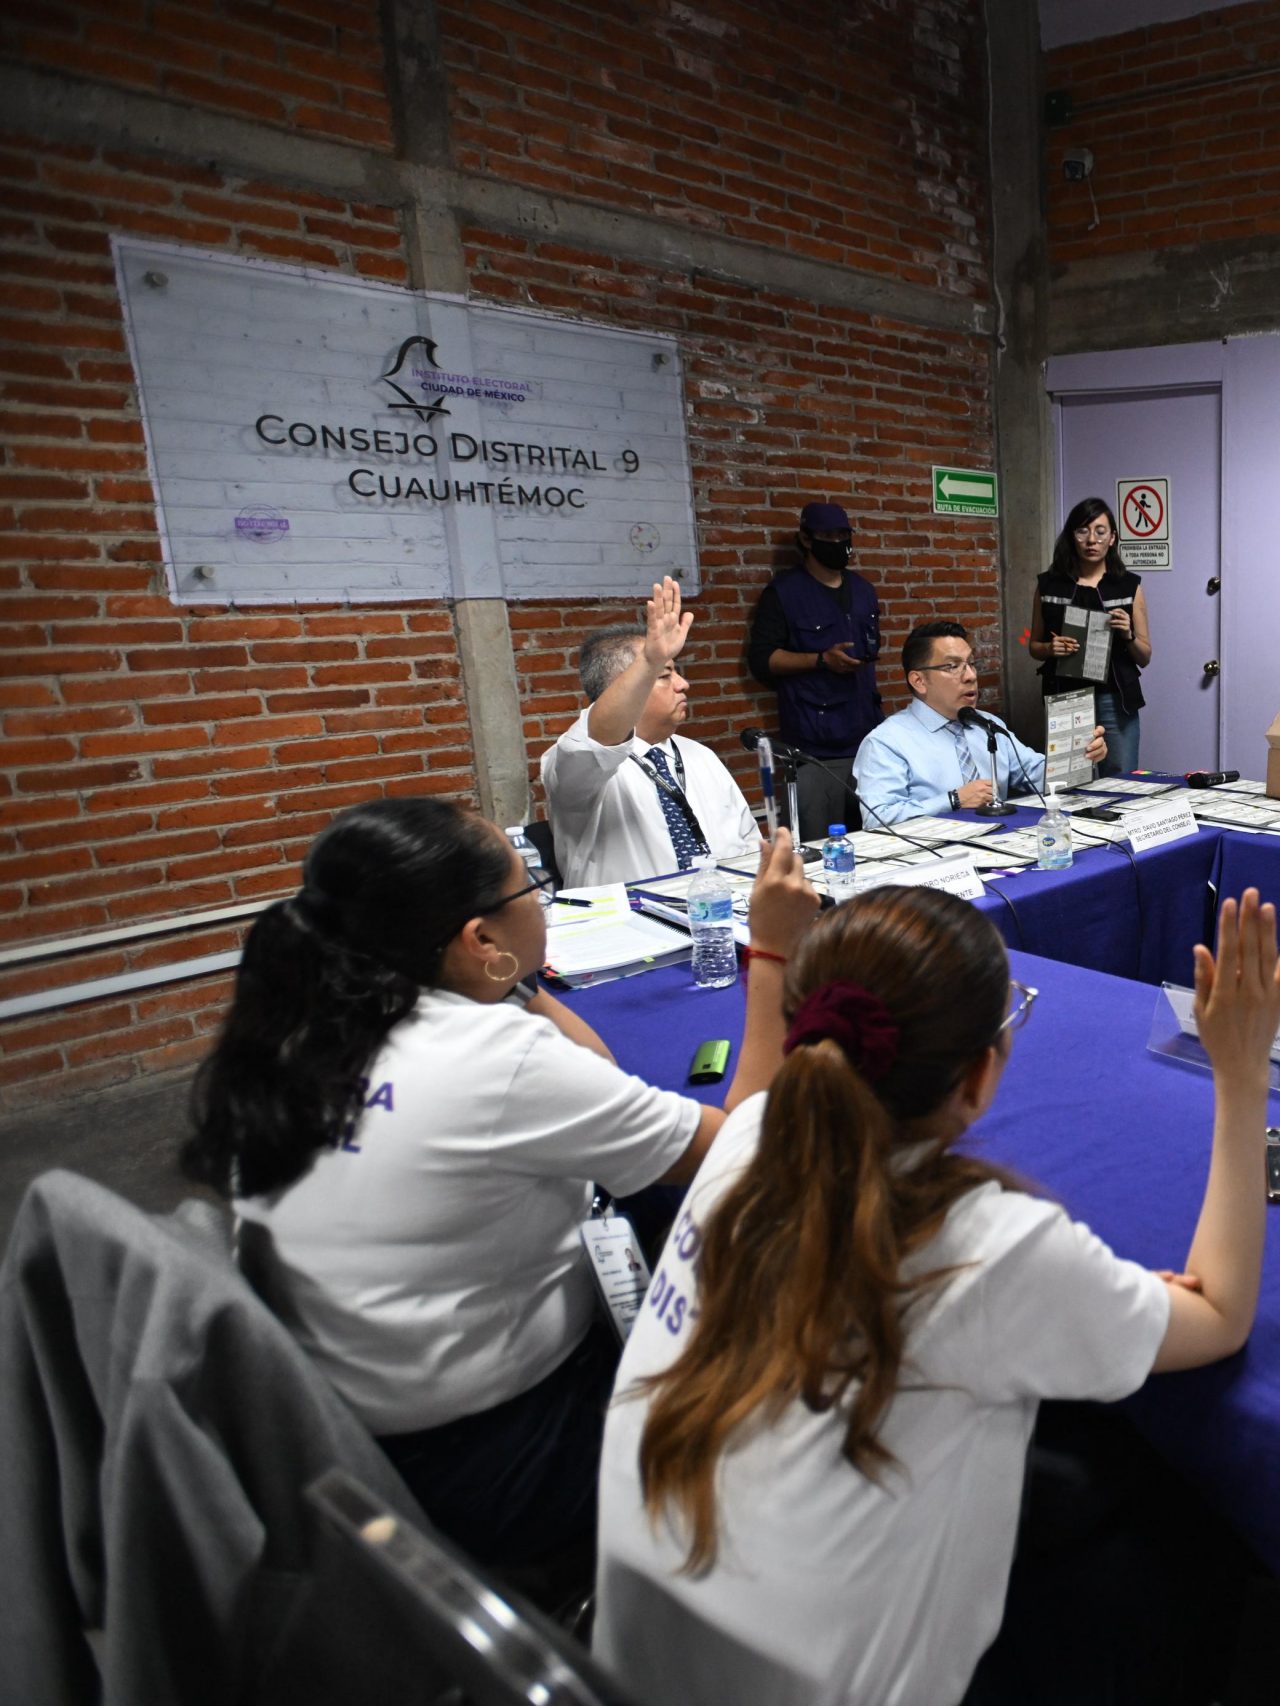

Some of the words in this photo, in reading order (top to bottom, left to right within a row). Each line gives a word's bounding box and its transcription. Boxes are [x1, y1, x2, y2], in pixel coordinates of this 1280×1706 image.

[412, 368, 470, 384] INSTITUTO
[472, 376, 532, 392] ELECTORAL
[421, 382, 463, 395] CIUDAD
[467, 387, 481, 397] DE
[485, 387, 525, 402] MÉXICO
[255, 414, 438, 457] CONSEJO
[451, 432, 606, 471] DISTRITAL
[622, 450, 639, 473] 9
[348, 468, 585, 509] CUAUHTÉMOC
[936, 503, 953, 511] RUTA
[940, 870, 970, 884] NORIEGA
